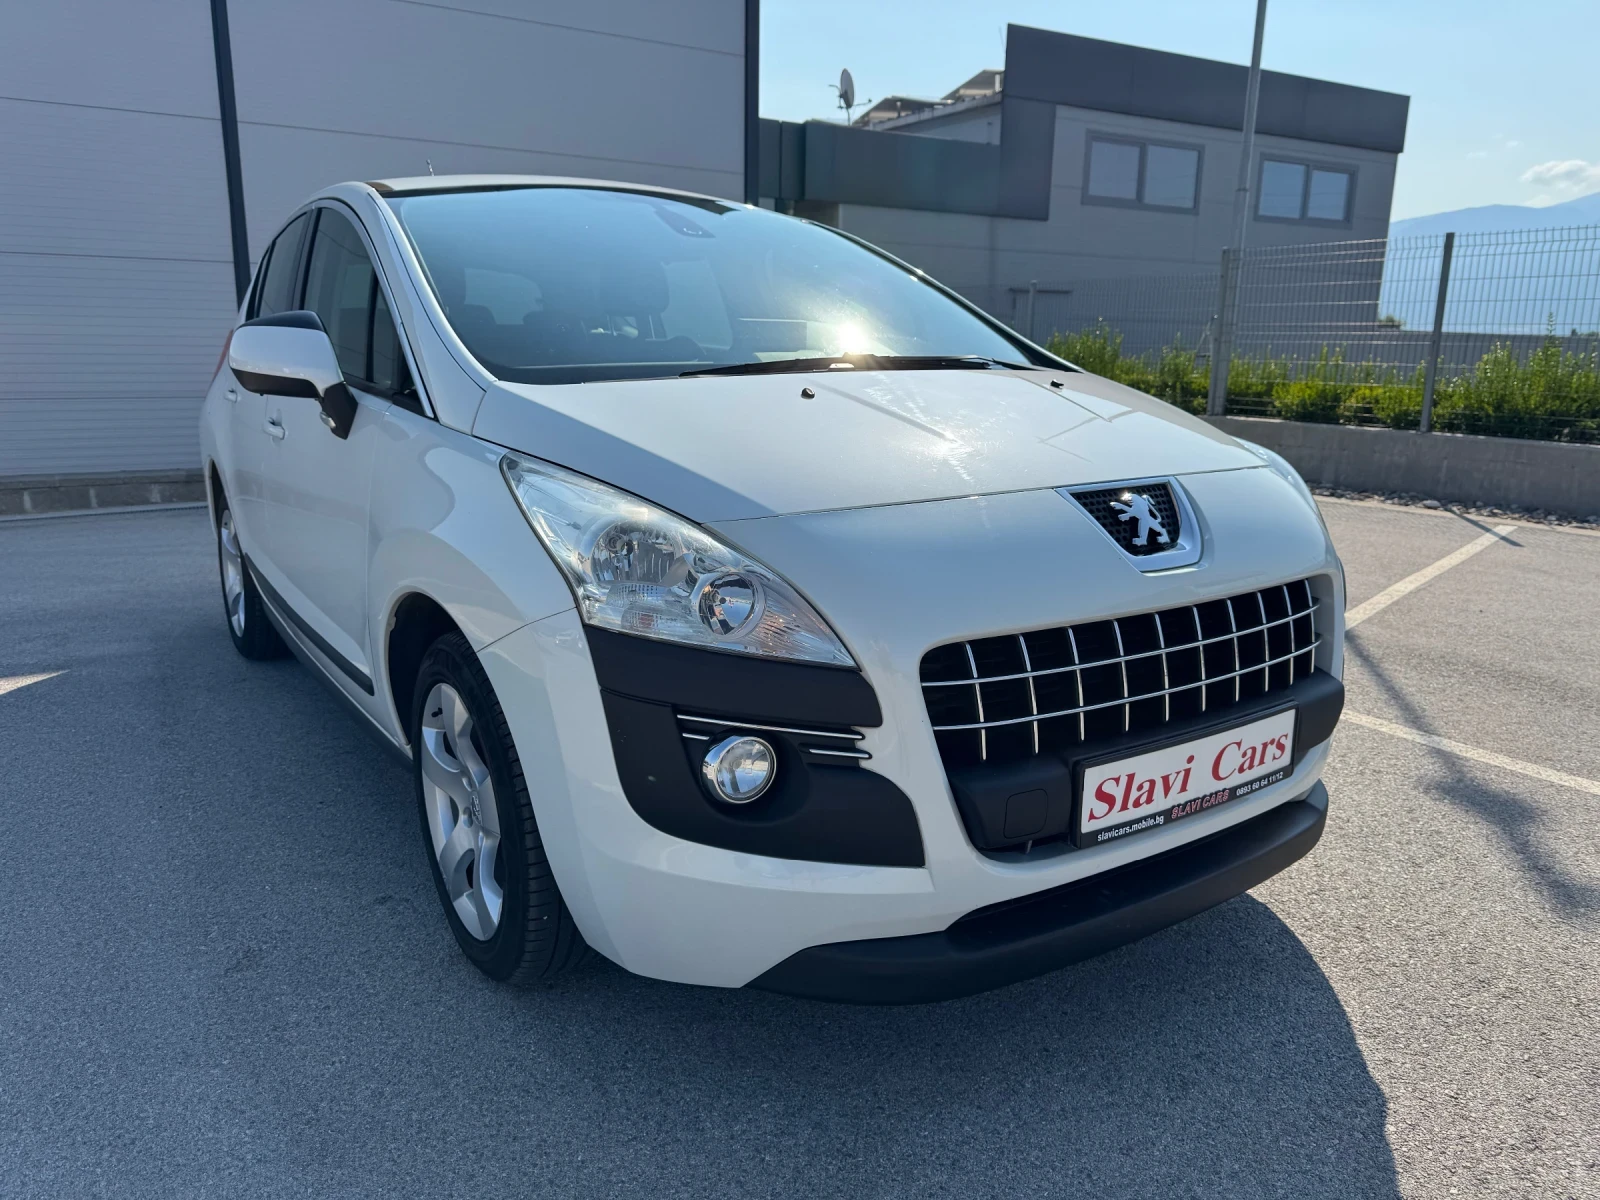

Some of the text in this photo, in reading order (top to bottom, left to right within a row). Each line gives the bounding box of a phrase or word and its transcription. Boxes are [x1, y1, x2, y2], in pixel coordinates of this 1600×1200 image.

[1087, 733, 1289, 822] Slavi Cars
[1236, 784, 1252, 796] 0893
[1252, 781, 1260, 790] 60
[1260, 777, 1268, 787] 64
[1171, 789, 1230, 819] SLAVI CARS
[1097, 815, 1164, 842] slavicars.mobile.bg
